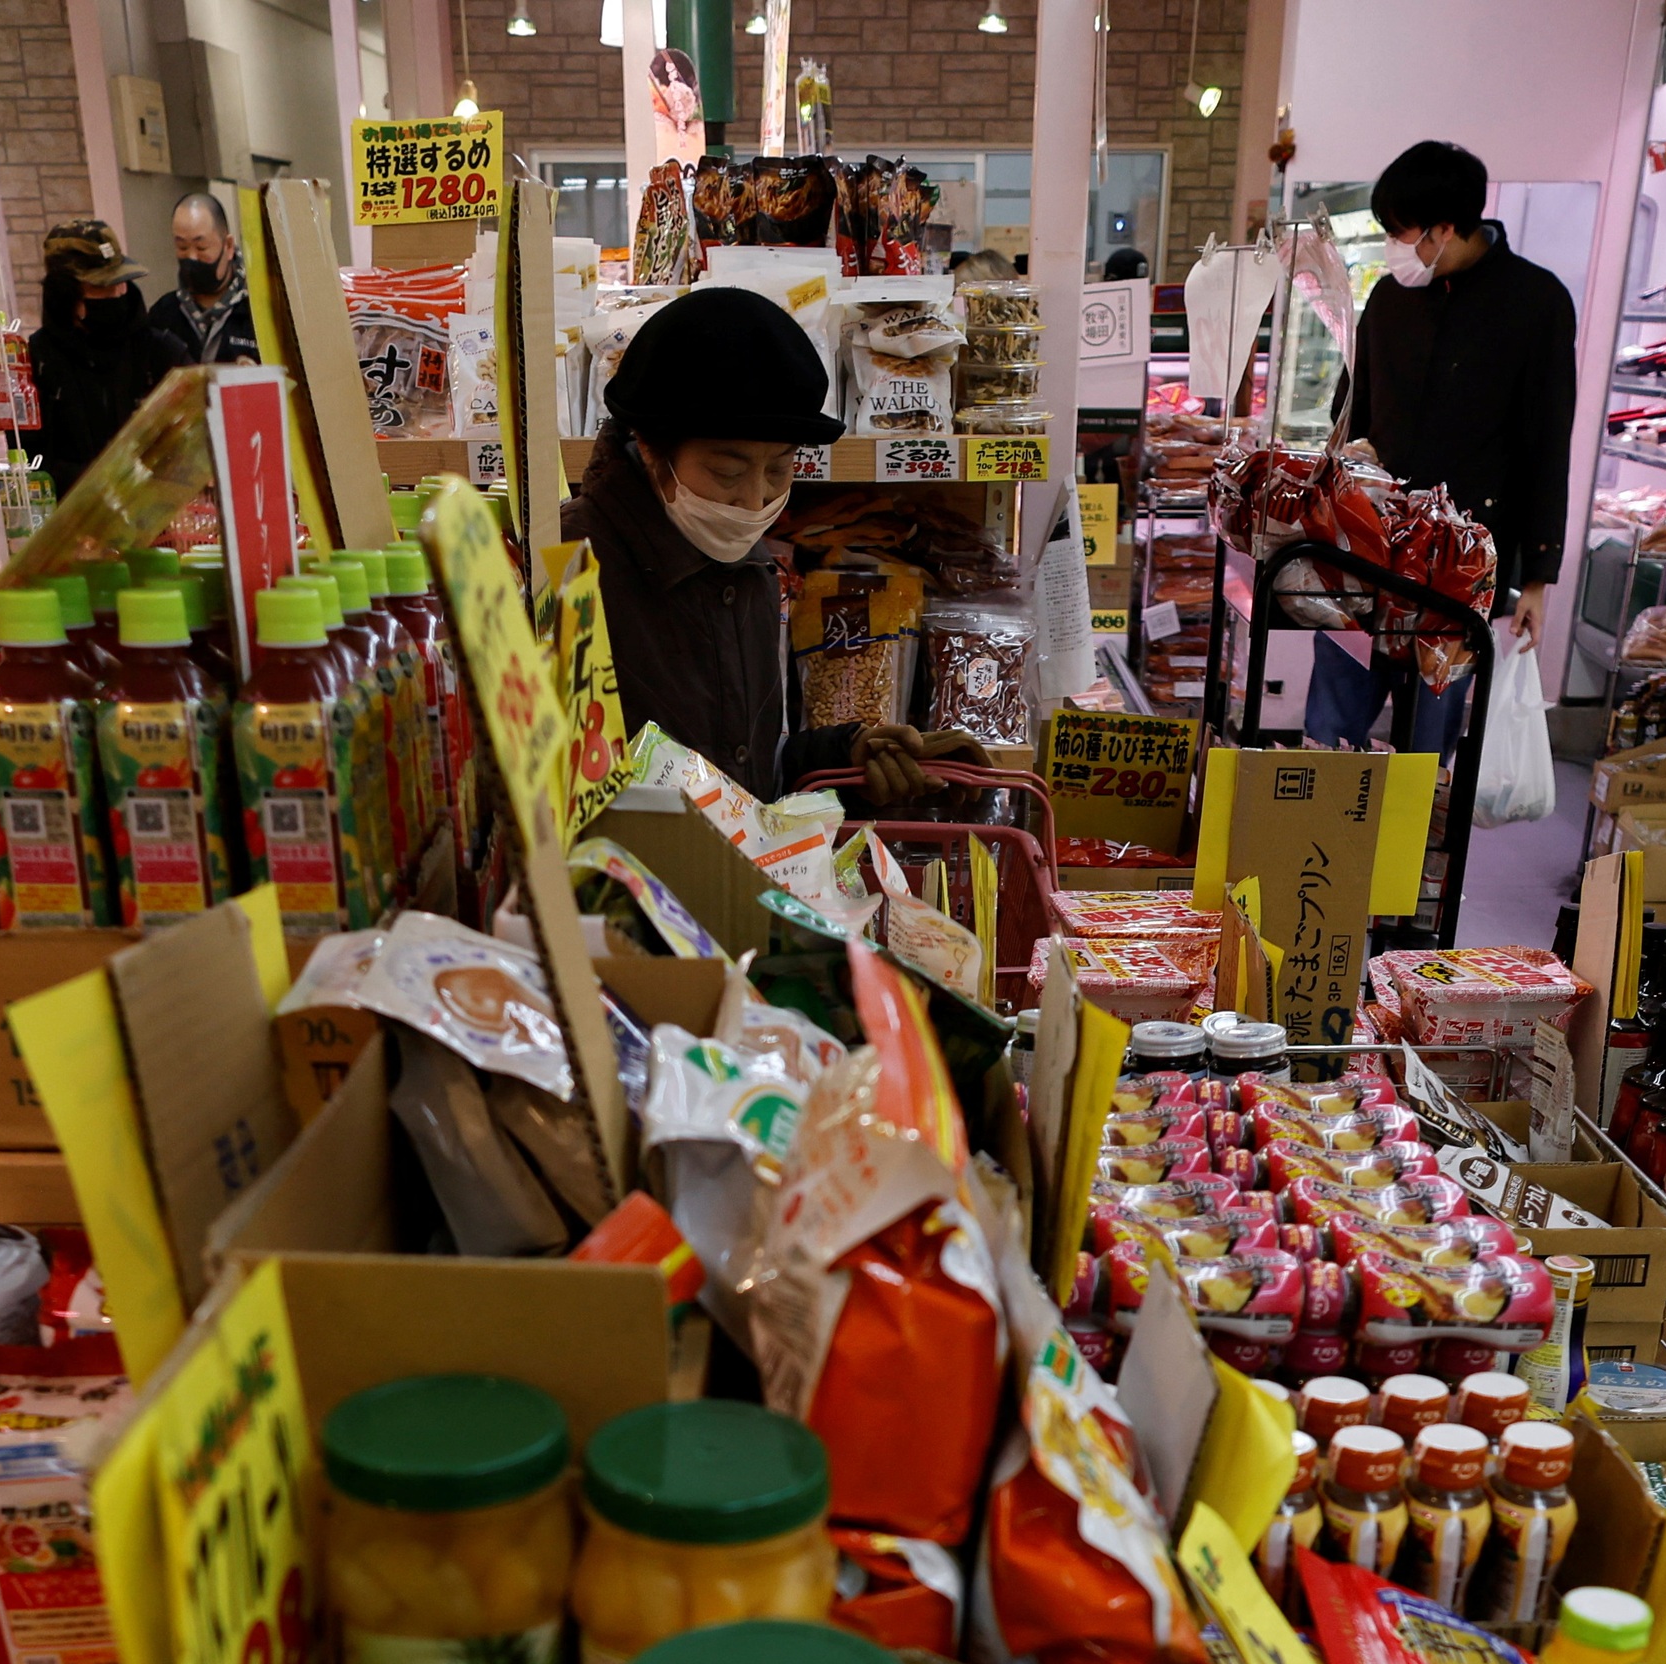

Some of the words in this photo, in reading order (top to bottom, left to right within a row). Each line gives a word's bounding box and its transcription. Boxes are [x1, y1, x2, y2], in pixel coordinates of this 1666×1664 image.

[366, 138, 490, 178] 特選するめ
[402, 173, 485, 208] 1280
[360, 211, 400, 219] アキダイ
[889, 381, 928, 394] THE
[885, 449, 952, 461] くるみ
[976, 449, 1042, 462] アーモンド小魚
[904, 461, 944, 474] 398
[995, 461, 1034, 474] 218
[1090, 767, 1165, 799] 280
[1352, 768, 1373, 823] HARADA
[1284, 840, 1332, 1003] たまごプリン
[1331, 938, 1348, 972] 16入
[1328, 981, 1341, 1002] 3P
